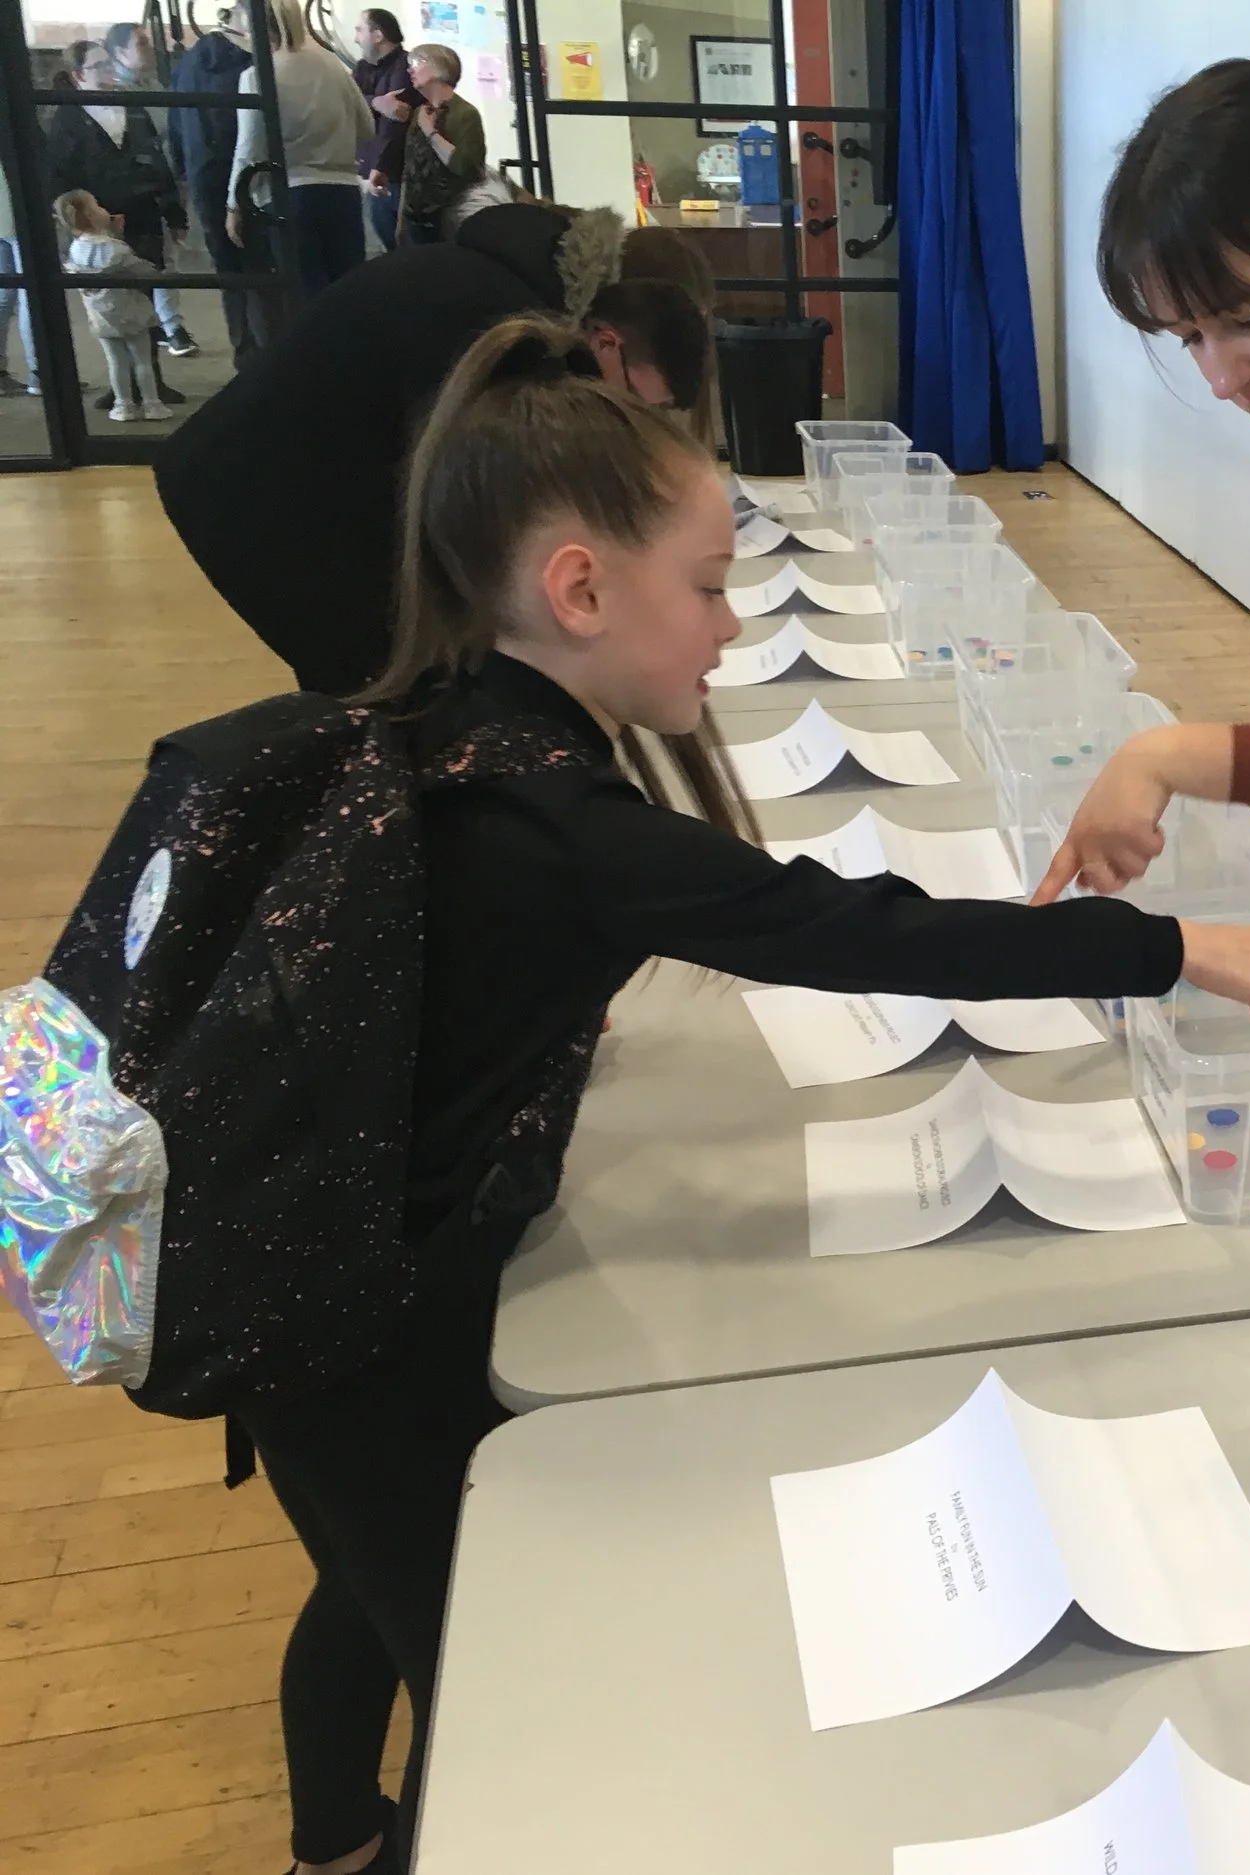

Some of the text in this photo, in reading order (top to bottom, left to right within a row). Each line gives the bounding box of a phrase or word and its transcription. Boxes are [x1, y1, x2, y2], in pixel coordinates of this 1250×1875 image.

[926, 1511, 941, 1536] PALS
[931, 1535, 945, 1548] OF
[950, 1490, 988, 1592] FAMILY FUN IN THE SUN
[936, 1548, 950, 1568] THE
